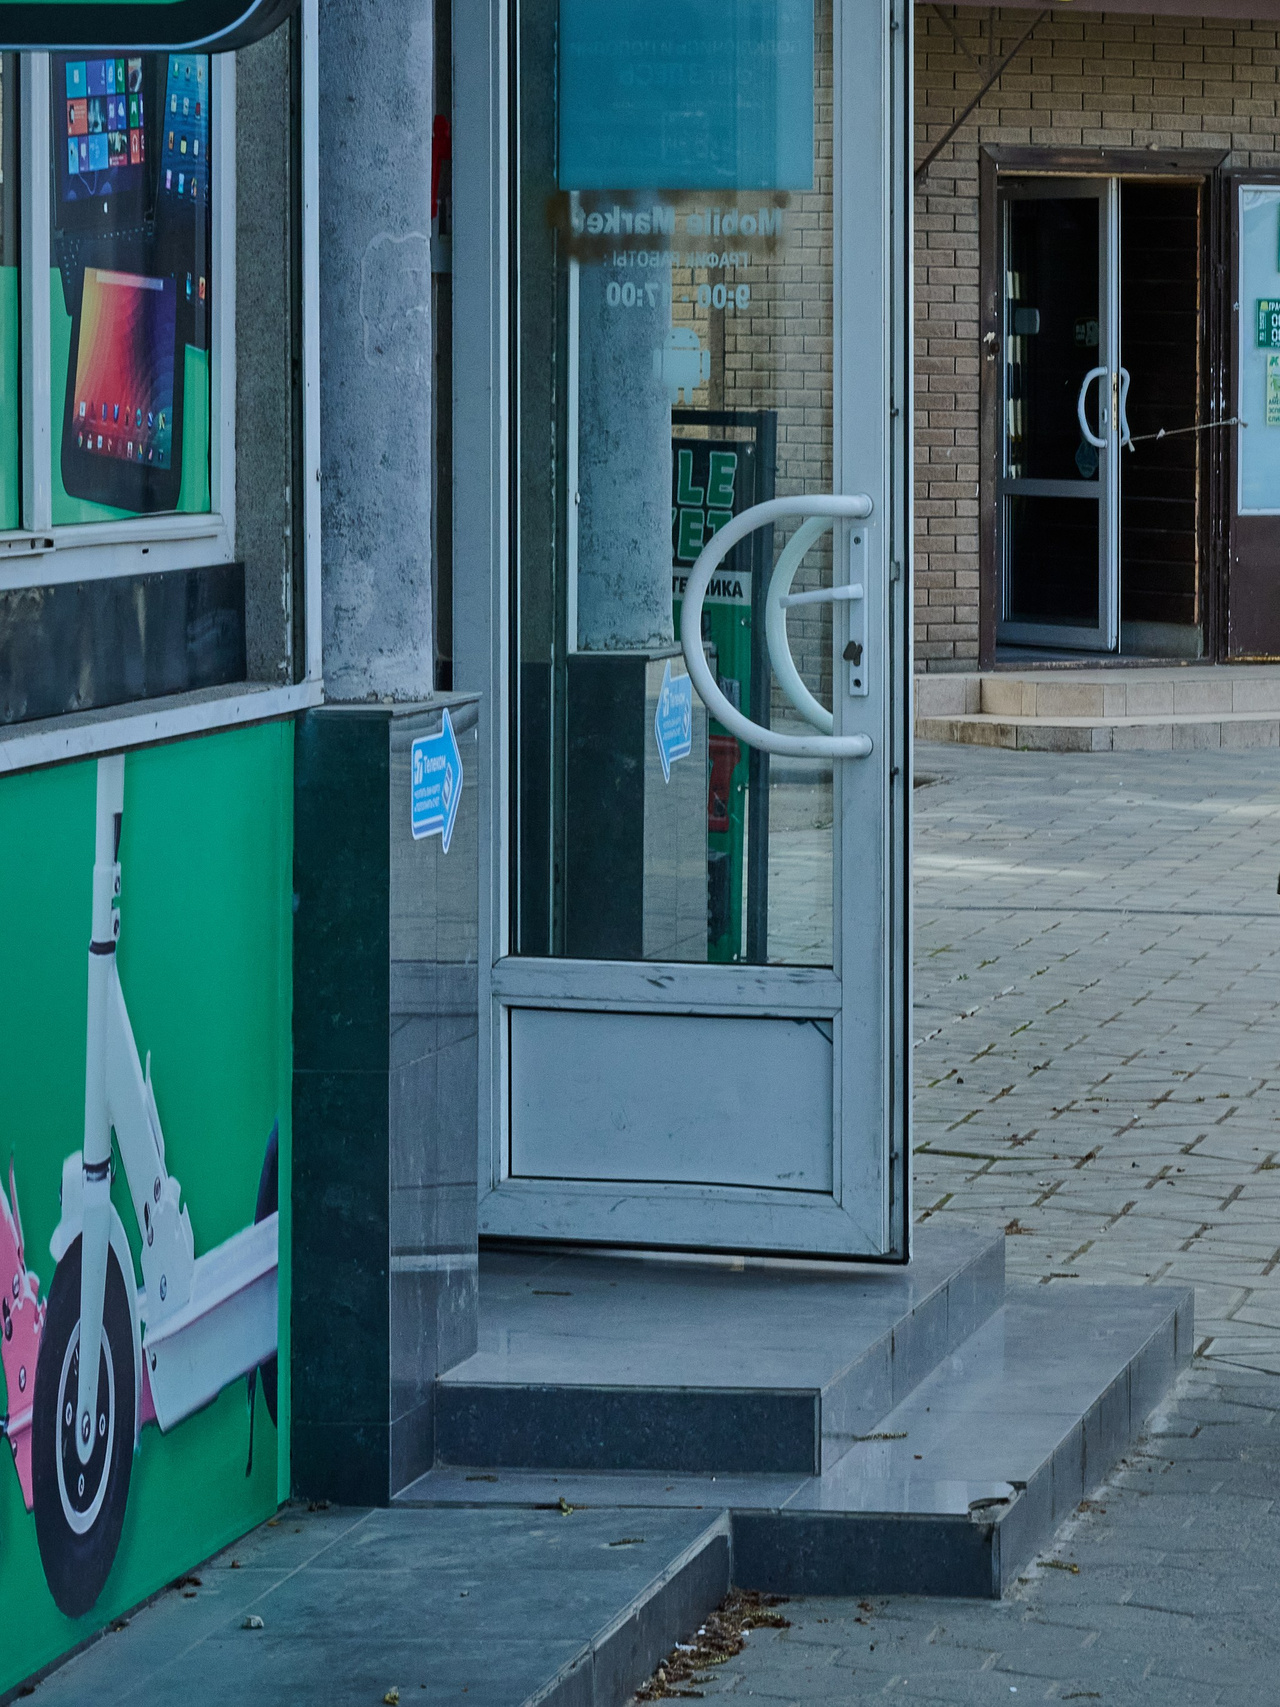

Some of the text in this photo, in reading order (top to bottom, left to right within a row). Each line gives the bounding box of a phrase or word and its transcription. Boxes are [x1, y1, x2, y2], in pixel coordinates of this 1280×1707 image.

[677, 449, 738, 508] LE
[672, 577, 743, 598] ТЕИКА
[423, 754, 446, 773] Телеком
